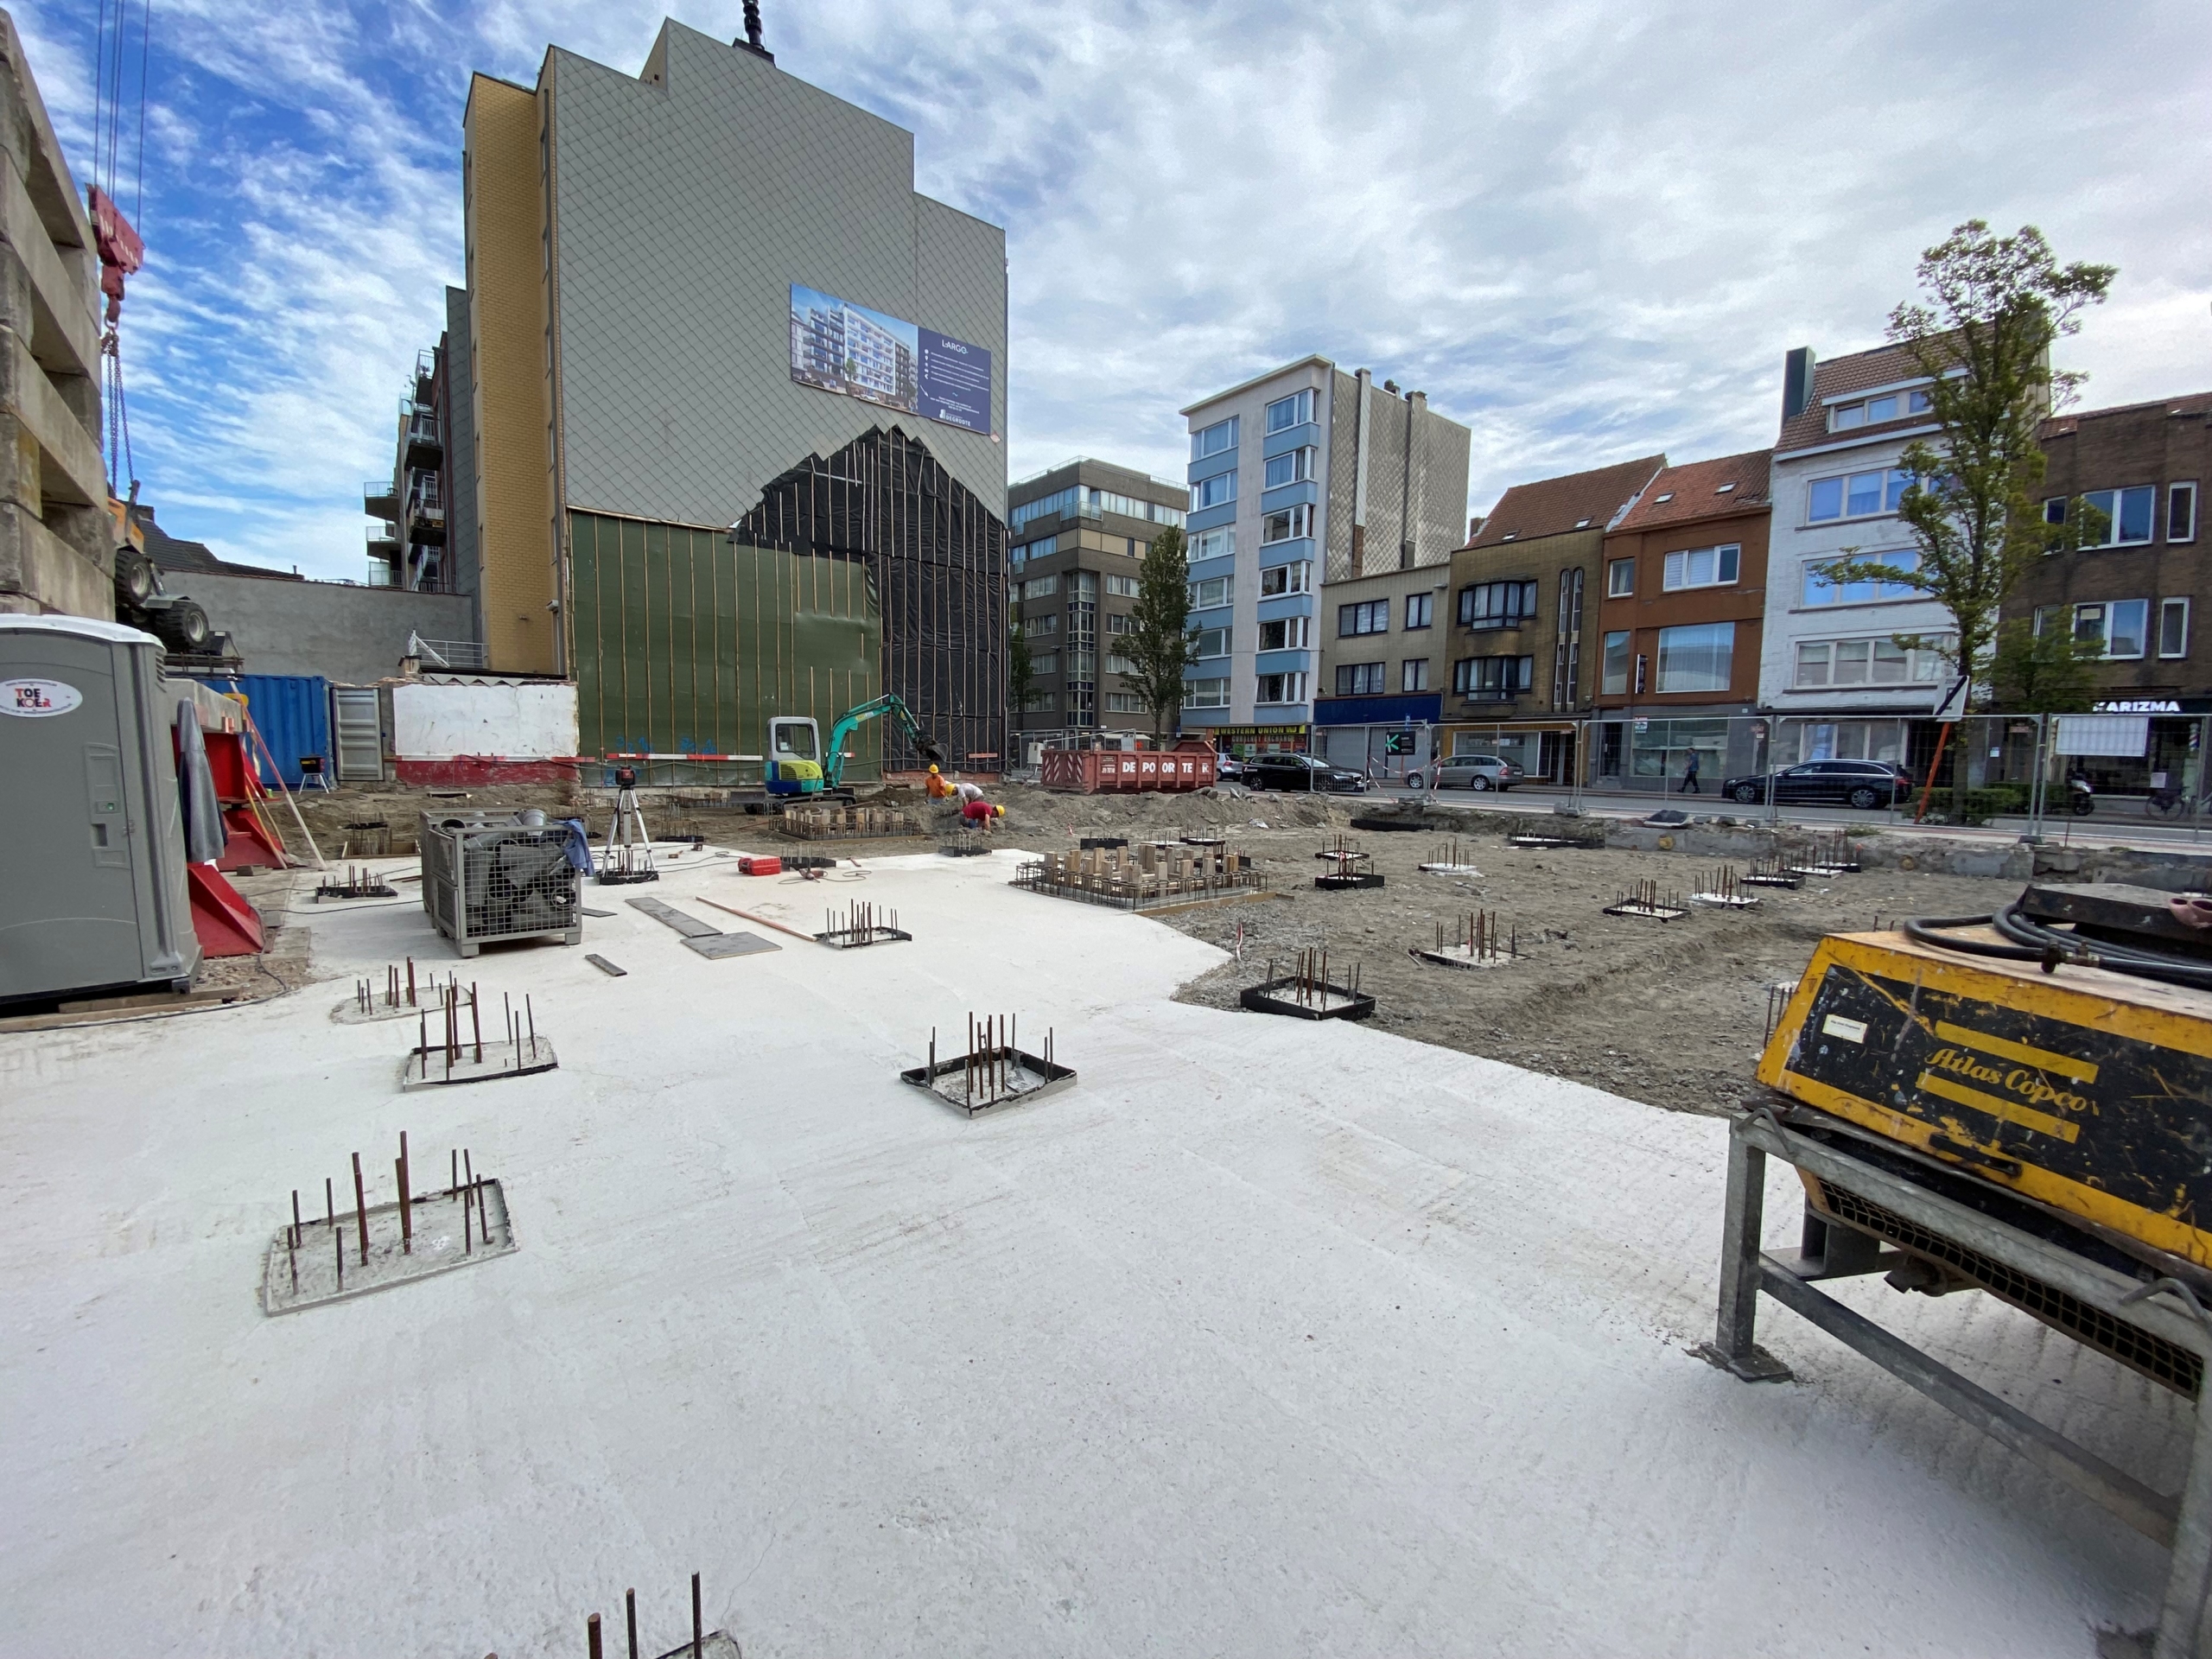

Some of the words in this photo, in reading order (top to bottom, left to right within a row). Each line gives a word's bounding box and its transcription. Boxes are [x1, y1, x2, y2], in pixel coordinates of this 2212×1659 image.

[942, 340, 967, 354] LARGO
[15, 689, 41, 698] TOE
[16, 698, 52, 708] KOER
[1924, 1048, 2003, 1084] Atlas
[2005, 1069, 2088, 1111] Copco
